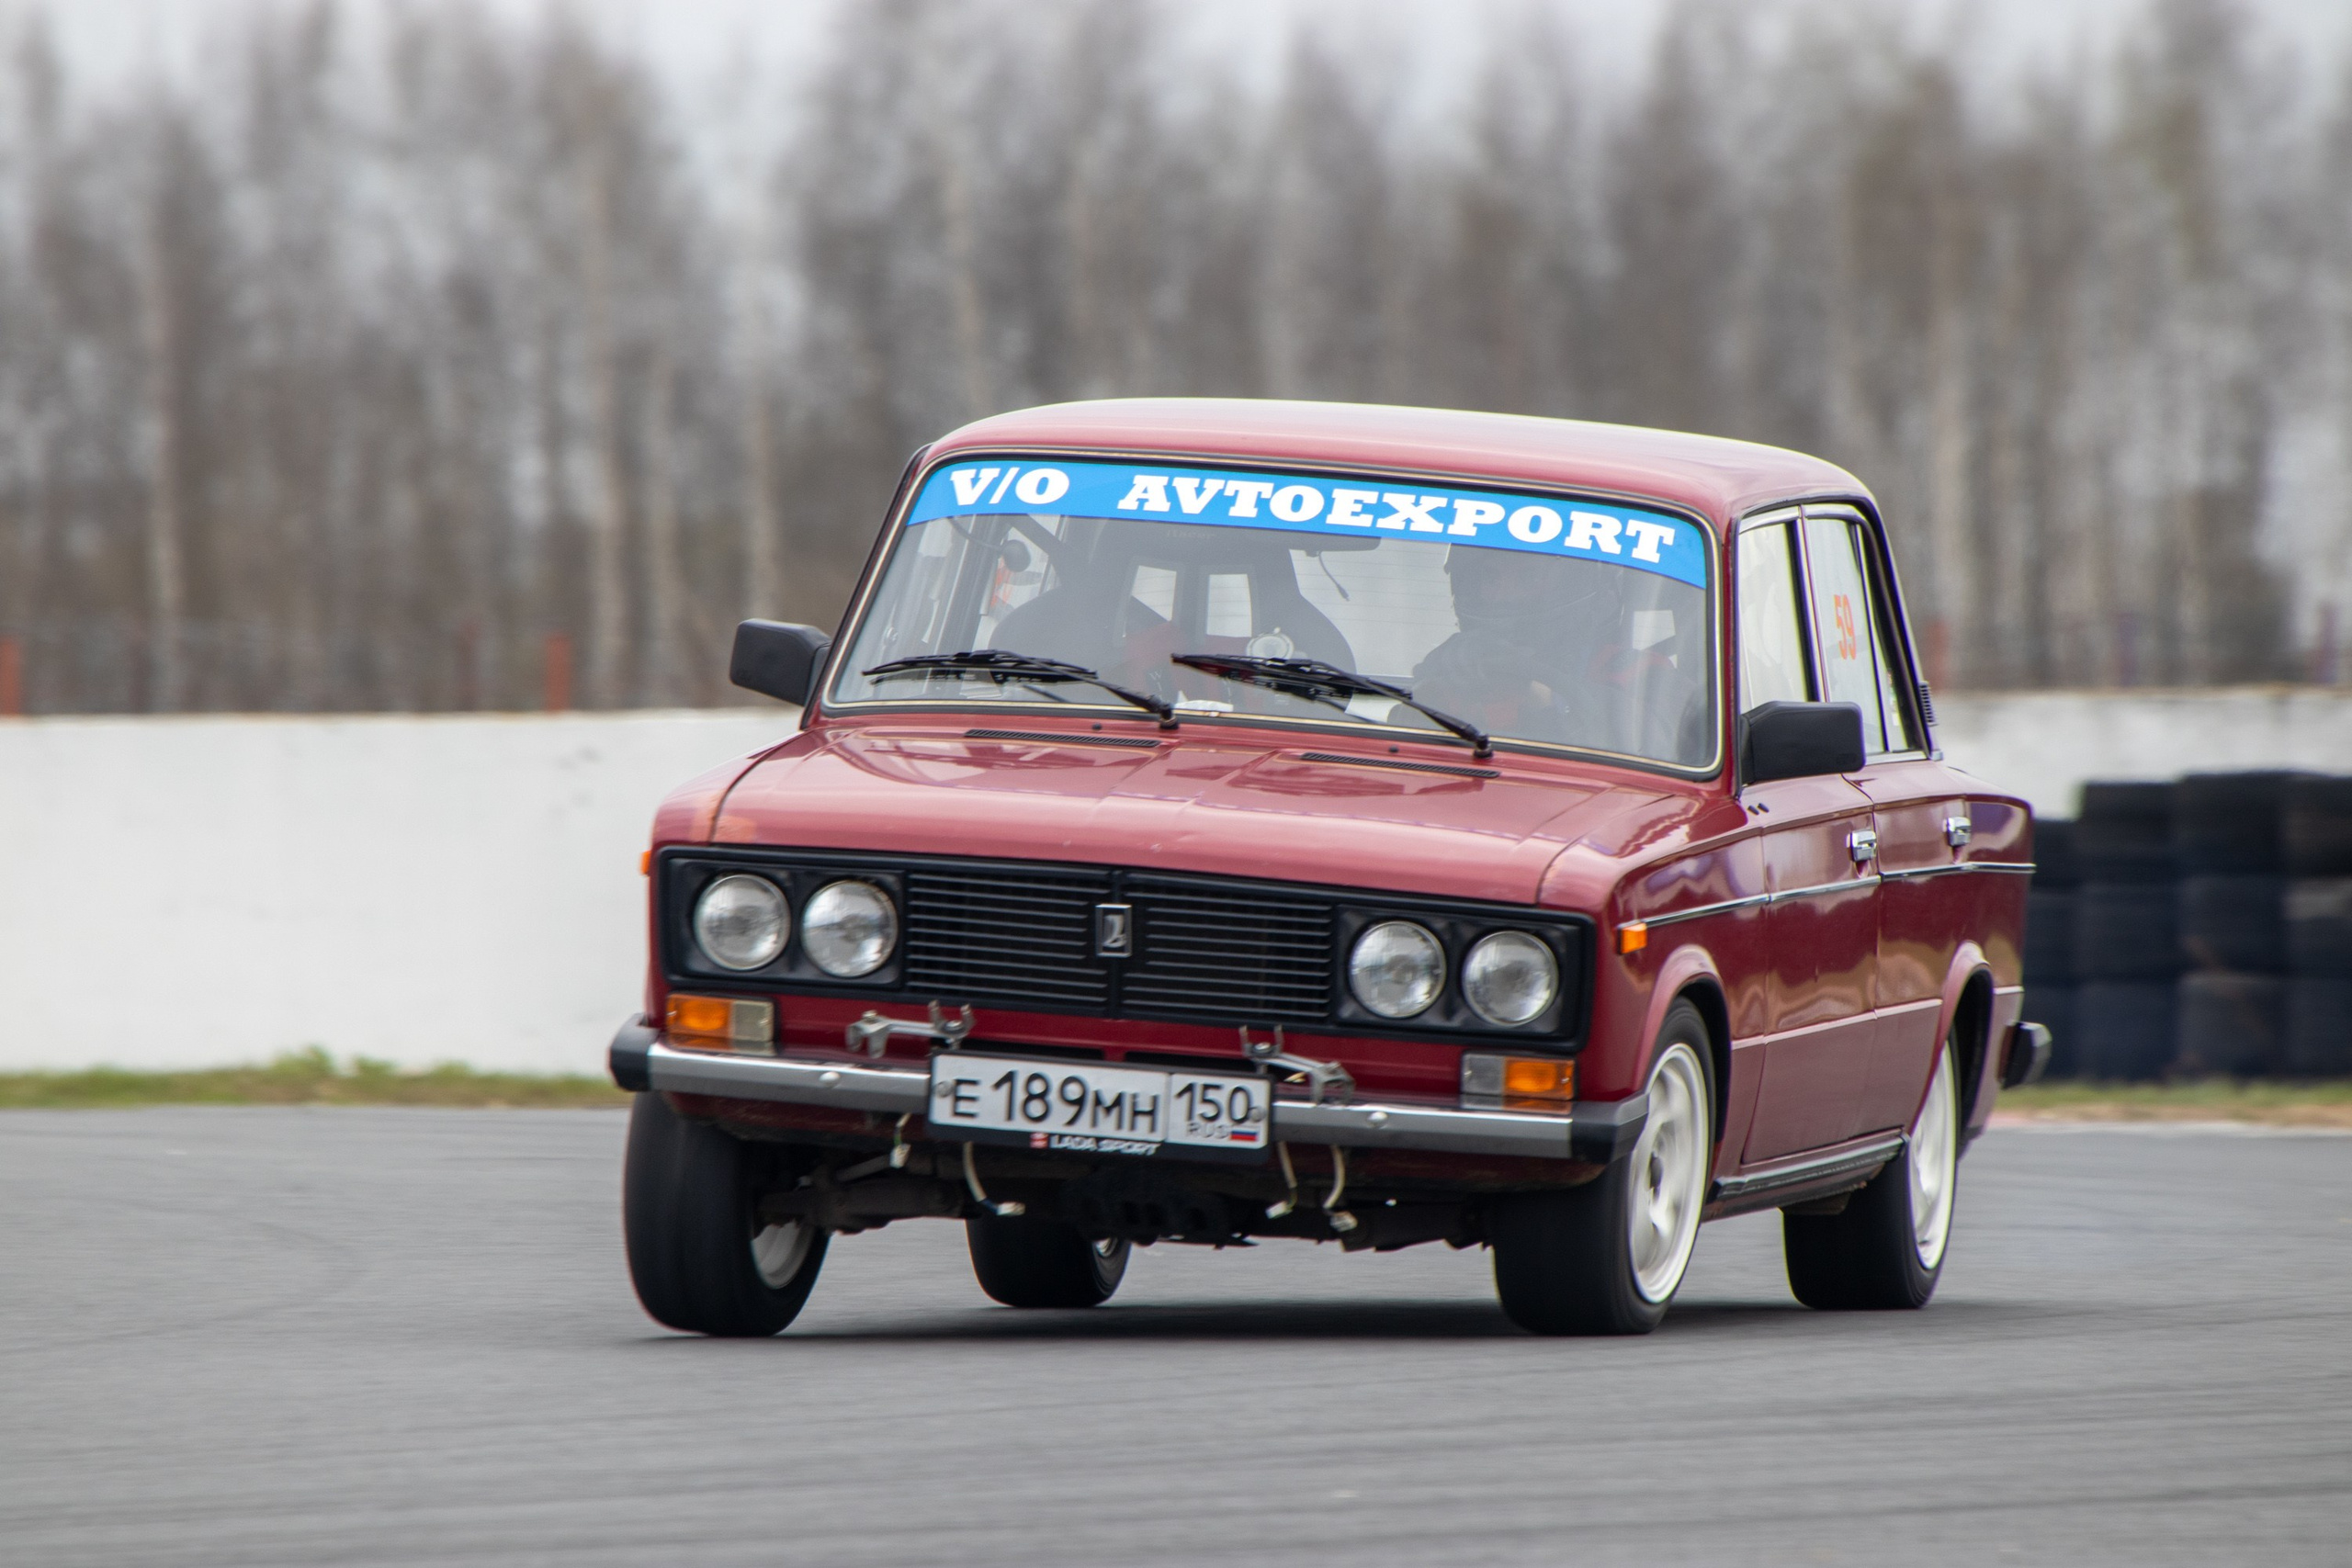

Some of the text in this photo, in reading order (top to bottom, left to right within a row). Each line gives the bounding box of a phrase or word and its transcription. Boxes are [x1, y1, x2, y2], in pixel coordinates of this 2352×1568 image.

[950, 467, 1676, 563] V/O AVTOEXPORT
[1834, 593, 1857, 660] 59
[1176, 1081, 1253, 1124] 150
[1049, 1134, 1161, 1156] LADA SPORT
[1186, 1122, 1230, 1139] RUS
